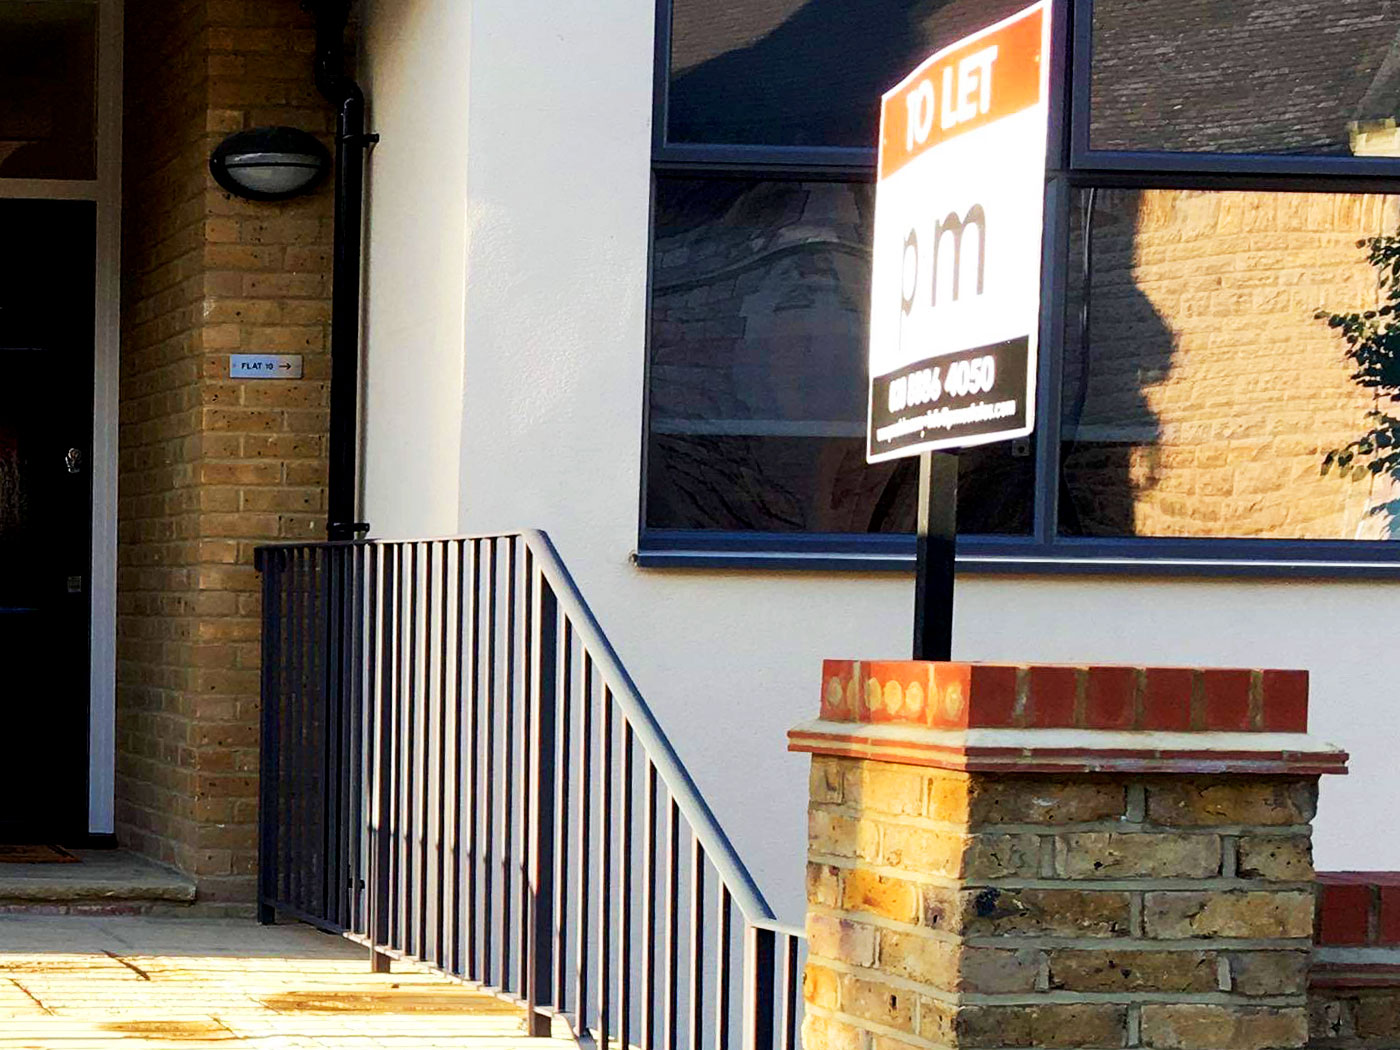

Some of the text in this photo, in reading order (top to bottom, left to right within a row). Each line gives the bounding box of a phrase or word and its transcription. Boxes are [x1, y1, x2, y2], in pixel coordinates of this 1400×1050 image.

[906, 44, 999, 152] TO LET
[241, 362, 274, 371] FLAT 10
